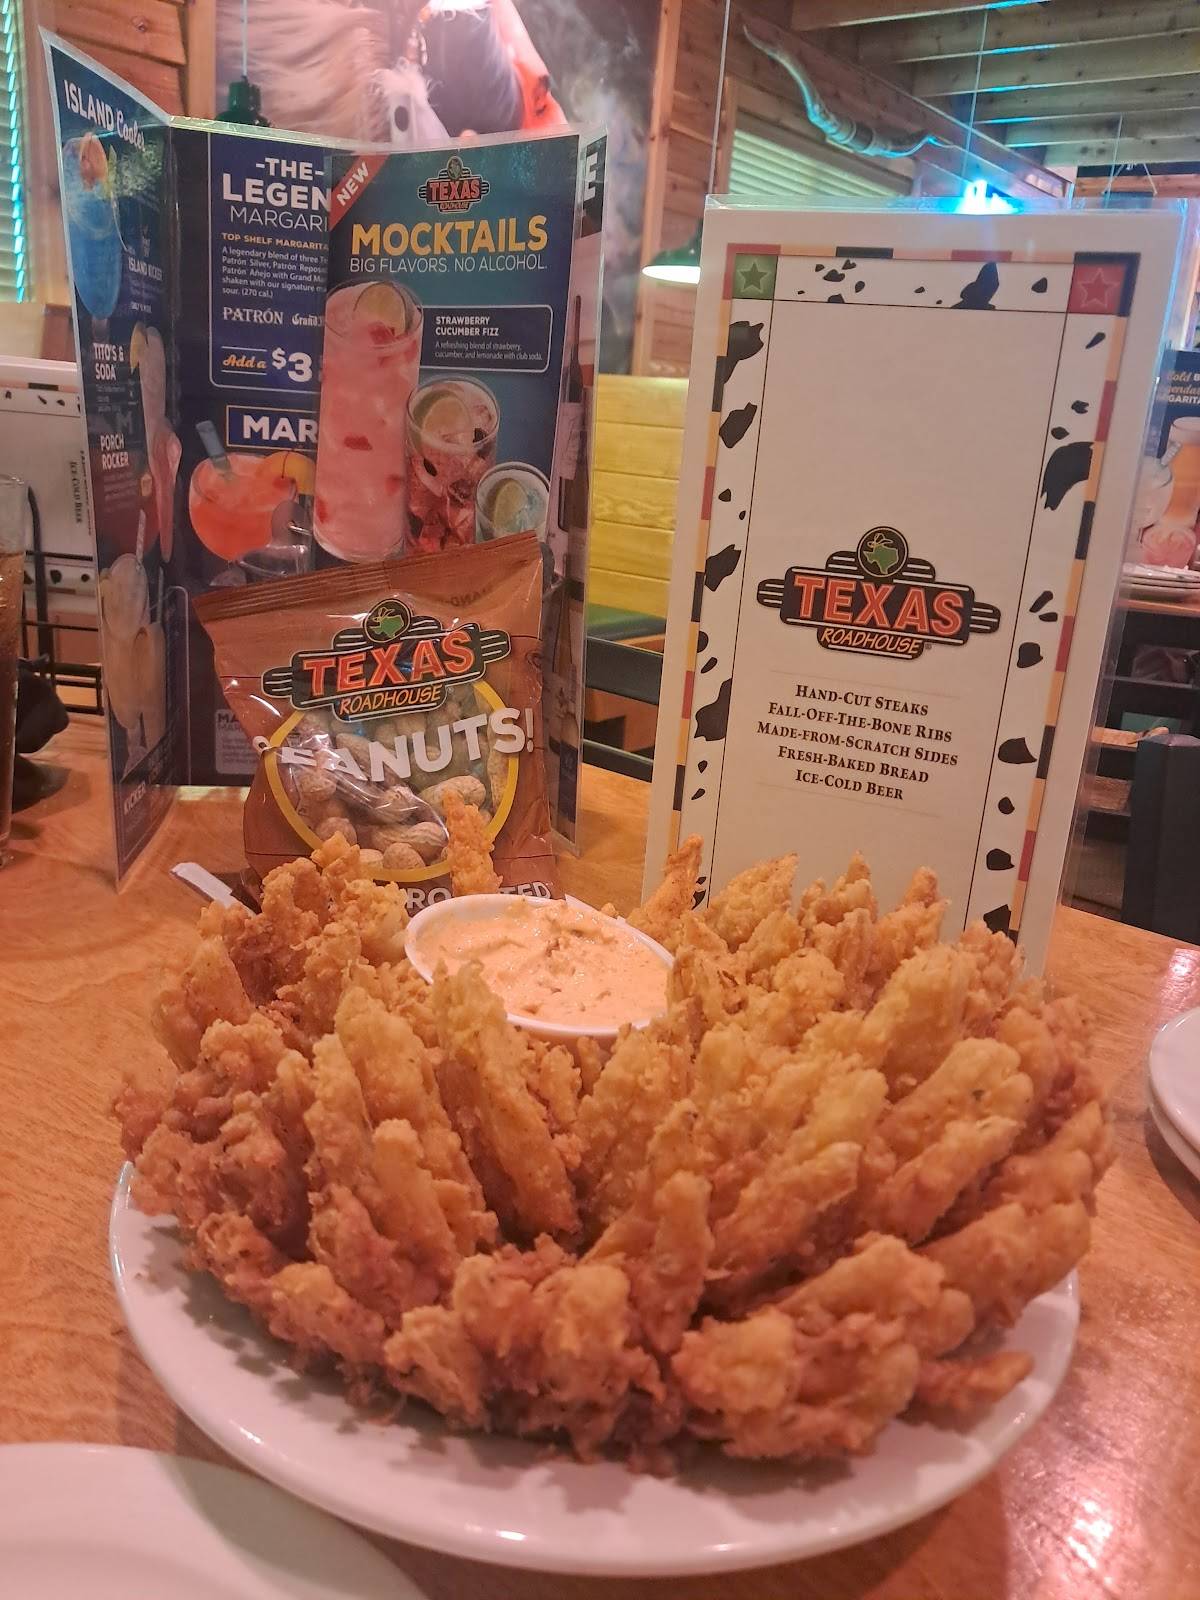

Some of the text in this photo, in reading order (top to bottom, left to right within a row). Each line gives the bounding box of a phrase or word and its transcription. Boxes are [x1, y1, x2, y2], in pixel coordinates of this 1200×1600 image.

[63, 79, 115, 132] ISLAND
[222, 172, 333, 212] LEGEN
[336, 162, 370, 206] NEW
[430, 179, 480, 201] TEXAS
[230, 205, 328, 232] MARGARI
[221, 232, 241, 242] TOP
[243, 235, 273, 246] SHELF
[351, 215, 548, 257] MOCKTAILS
[222, 246, 228, 254] A
[229, 246, 266, 260] legendary
[267, 250, 289, 261] blend
[290, 252, 298, 261] of
[299, 254, 319, 263] three
[222, 256, 247, 265] Patrón
[272, 261, 297, 271] Patrón
[350, 253, 548, 273] BIG FLAVORS. NO ALCOHOL.
[222, 266, 247, 275] Patrón
[272, 271, 288, 280] with
[290, 272, 312, 282] Grand
[222, 276, 248, 285] shaken
[249, 278, 266, 287] with
[281, 280, 314, 292] signature
[241, 287, 257, 297] (270
[223, 306, 284, 325] PATRÓN
[435, 316, 490, 325] STRAWBERRY
[435, 327, 499, 336] CUCUMBER FIZZ
[93, 342, 124, 362] TITO'S &
[469, 341, 485, 350] blend
[95, 363, 116, 380] SODA
[222, 354, 256, 368] Add
[256, 360, 267, 369] a
[243, 414, 318, 444] MAR
[100, 433, 125, 452] PORCH
[102, 452, 129, 471] ROCKER
[793, 573, 965, 637] TEXAS
[820, 626, 923, 655] ROADHOUSE
[303, 630, 475, 697] TEXAS
[339, 684, 443, 716] ROADHOUSE
[795, 684, 929, 716] HAND-CUT STEAKS
[768, 702, 953, 743] FALL-OFF-THE-BONE RIBS
[756, 721, 958, 766] MADE-FROM-SCRATCH SIDES
[778, 746, 929, 783] FRESH-BAKED BREAD
[795, 769, 904, 801] ICE-COLD BEER
